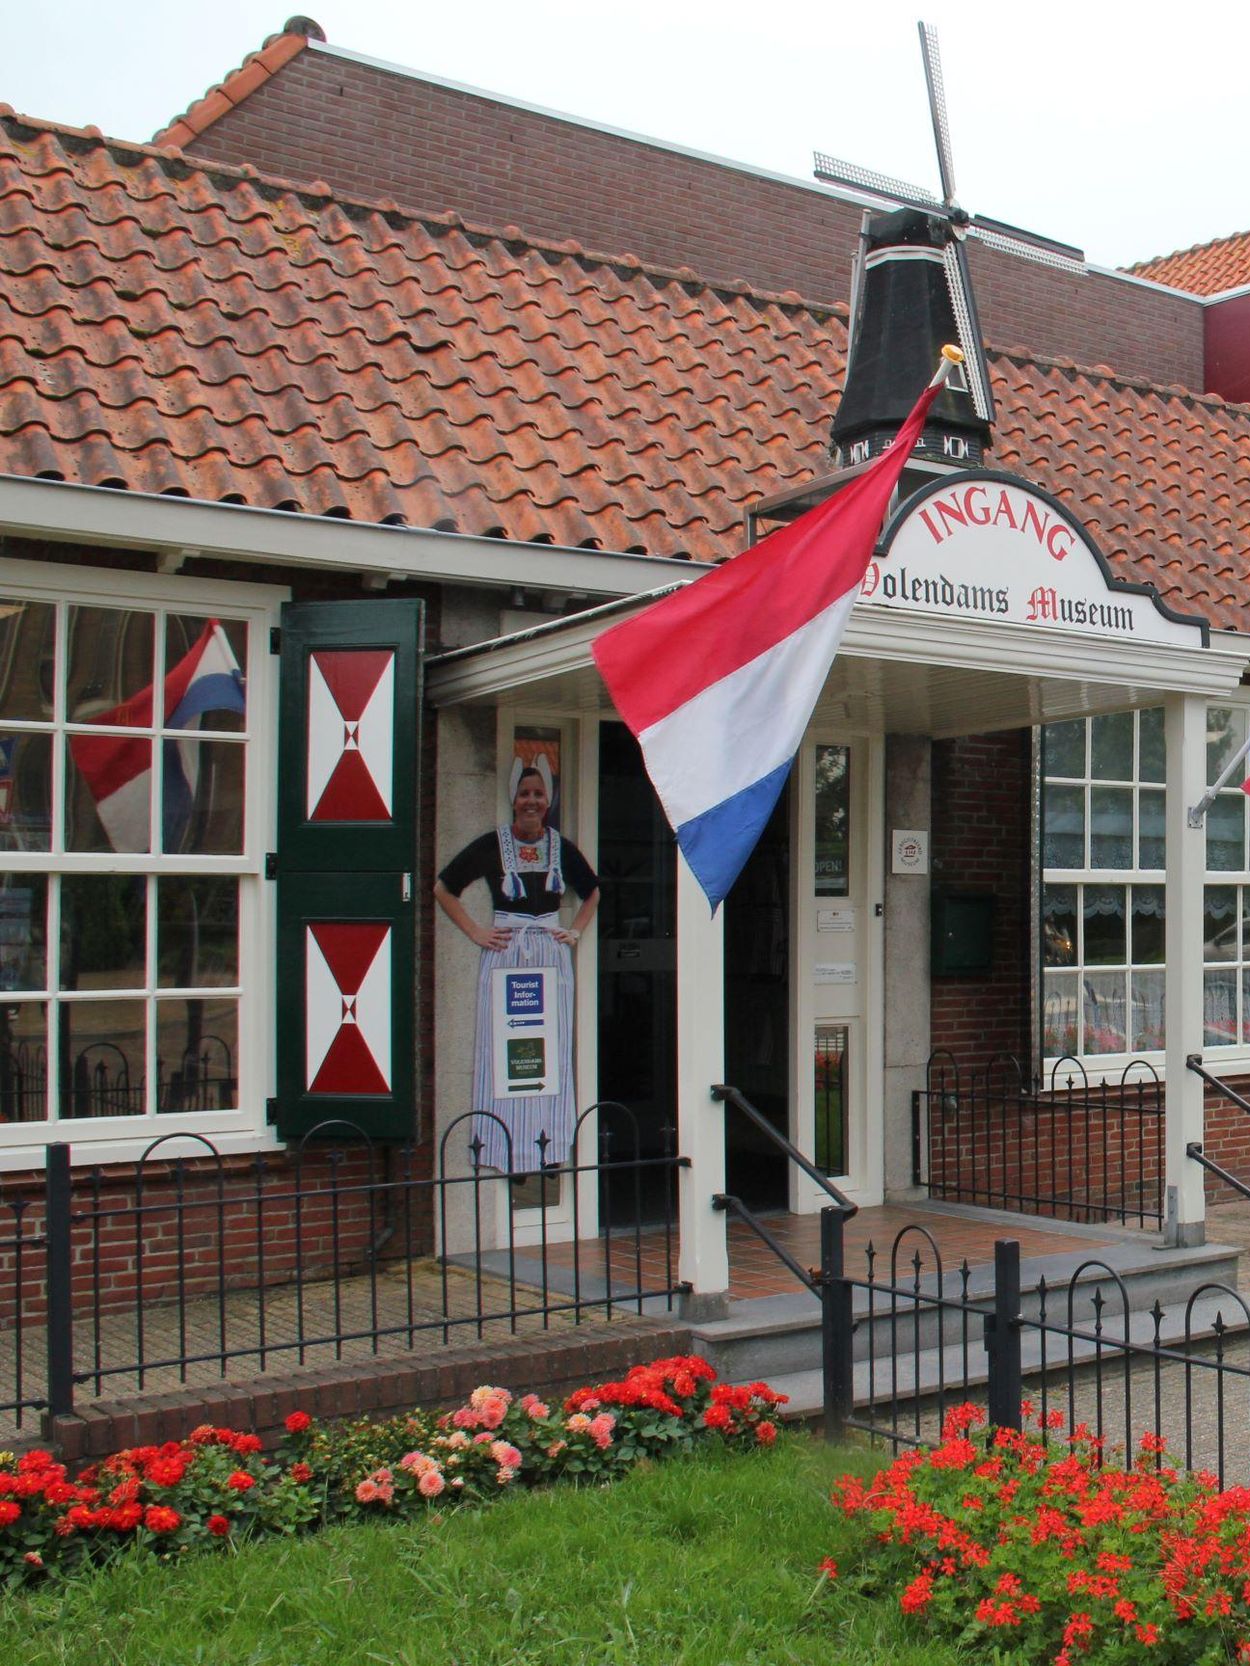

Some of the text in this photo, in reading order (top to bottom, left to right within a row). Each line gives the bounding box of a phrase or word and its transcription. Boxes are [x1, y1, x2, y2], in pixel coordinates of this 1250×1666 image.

[918, 486, 1076, 561] INGANG
[860, 562, 1134, 631] Volendams Museum
[511, 981, 539, 989] Tourist
[511, 999, 539, 1007] mation
